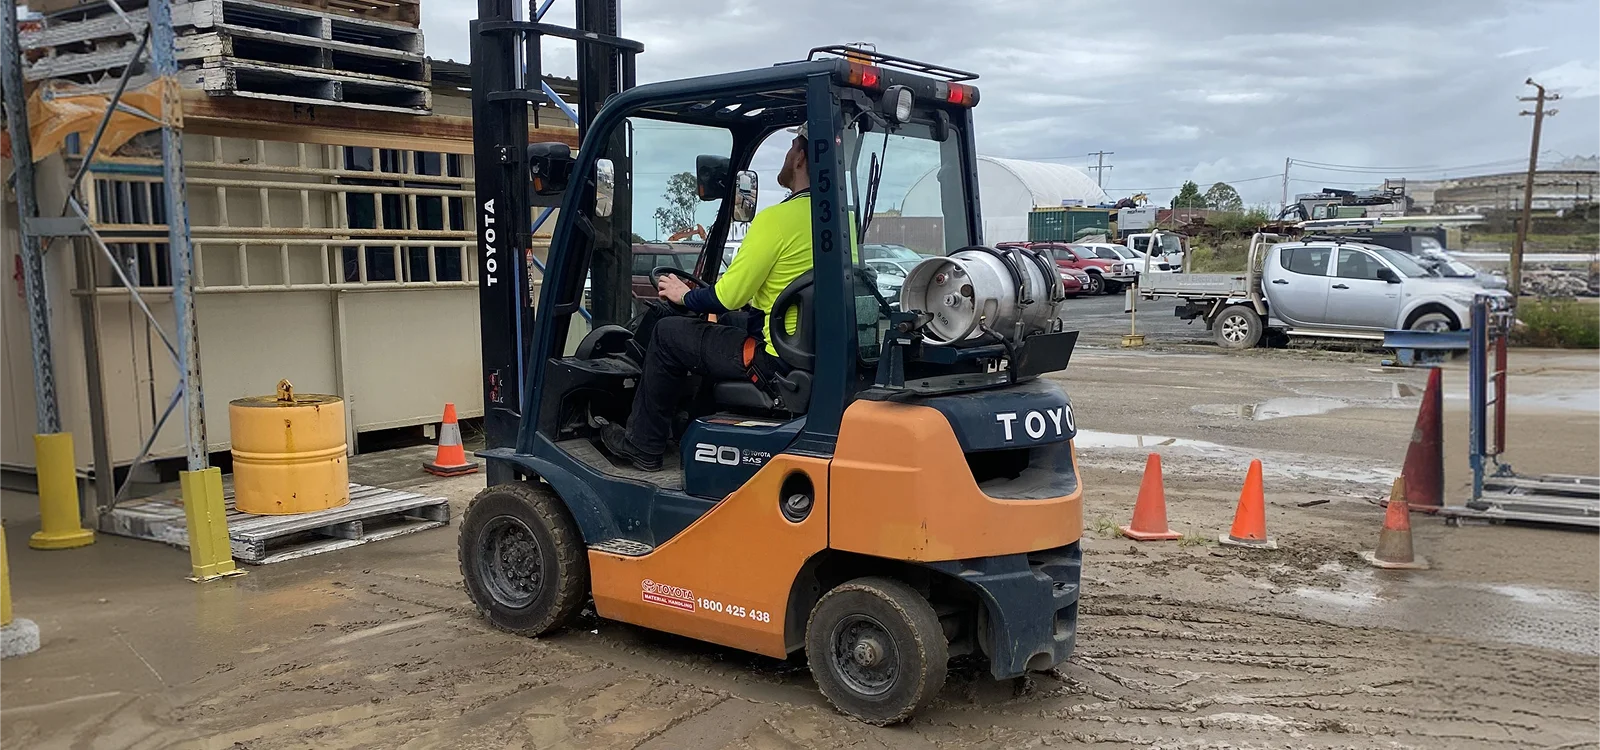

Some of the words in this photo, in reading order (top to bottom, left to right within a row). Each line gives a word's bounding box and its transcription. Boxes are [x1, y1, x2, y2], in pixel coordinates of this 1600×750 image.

[484, 198, 498, 287] TOYOTA
[694, 442, 740, 466] 20
[742, 456, 762, 464] SAS
[750, 450, 771, 458] TOYOTA
[656, 583, 694, 600] TOYOTA
[644, 594, 668, 603] MATERIAL
[667, 599, 693, 609] HANDLING
[697, 597, 723, 613] 1800
[725, 604, 746, 618] 425
[749, 609, 770, 623] 438
